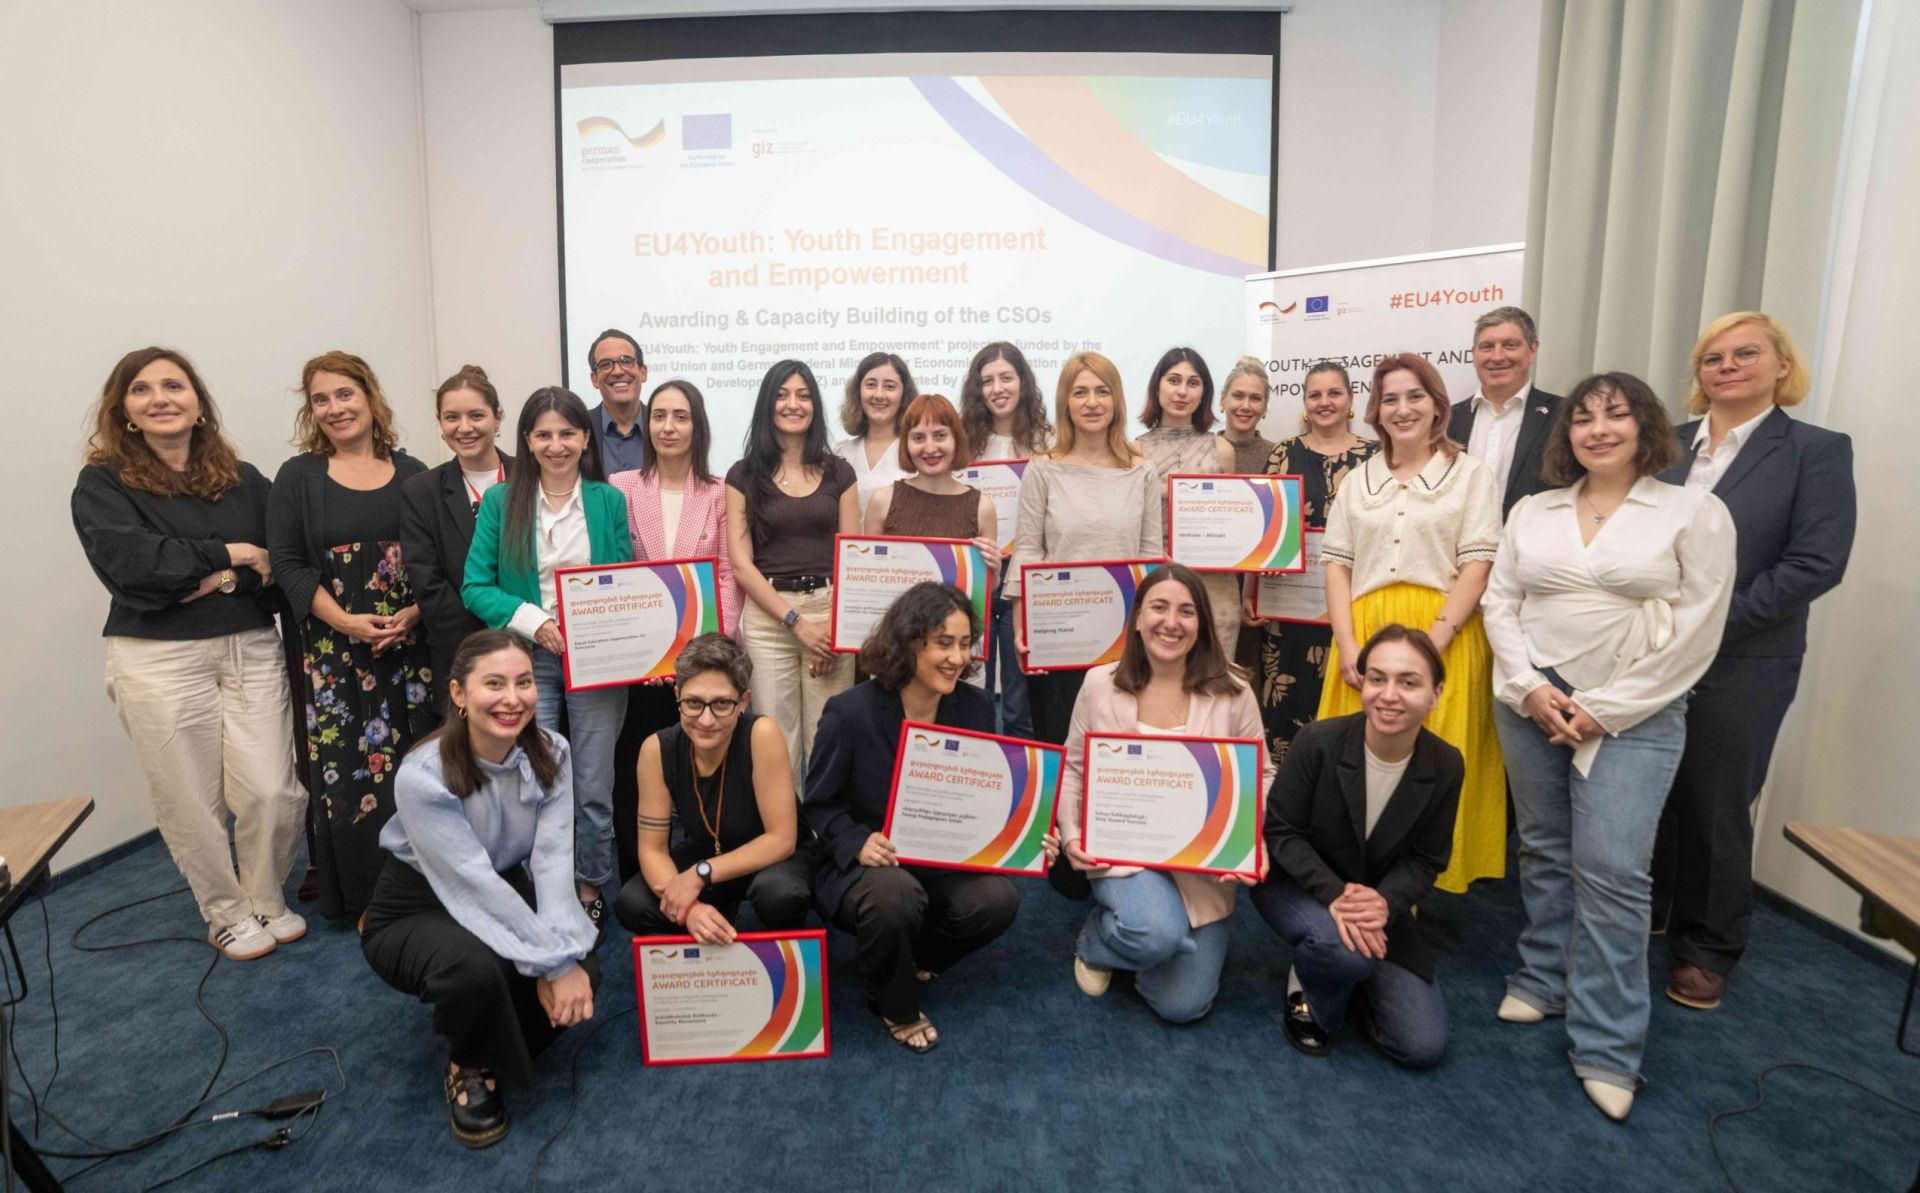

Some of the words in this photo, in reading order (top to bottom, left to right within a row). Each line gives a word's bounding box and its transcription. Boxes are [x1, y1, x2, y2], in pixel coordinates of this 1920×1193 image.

[581, 146, 620, 159] german
[752, 141, 774, 158] giz
[581, 155, 627, 165] cooperation
[634, 231, 774, 257] EU4Youth:
[785, 227, 862, 252] Youth
[872, 227, 1047, 256] Engagement
[708, 264, 759, 288] and
[769, 261, 969, 291] Empowerment
[1389, 284, 1504, 310] #EU4Youth
[639, 311, 729, 331] Awarding
[736, 309, 749, 326] &
[755, 307, 840, 329] Capacity
[847, 306, 928, 327] Building
[934, 306, 954, 324] of
[960, 306, 990, 323] the
[996, 306, 1052, 324] CSOs
[703, 341, 737, 354] Youth
[741, 340, 819, 354] Engagement
[822, 340, 845, 351] and
[1015, 339, 1061, 351] funded
[1063, 339, 1078, 352] by
[1082, 339, 1102, 351] the
[1437, 350, 1474, 365] AND
[671, 361, 707, 372] Union
[711, 360, 734, 371] and
[943, 375, 957, 387] by
[1207, 506, 1254, 514] CERTIFICATE
[845, 574, 878, 583] AWARD
[571, 607, 606, 617] AWARD
[607, 600, 664, 613] CERTIFICATE
[1032, 599, 1063, 607] AWARD
[1064, 596, 1114, 606] CERTIFICATE
[908, 769, 944, 782] AWARD
[945, 774, 1003, 790] CERTIFICATE
[1096, 776, 1131, 785] AWARD
[1133, 778, 1194, 790] CERTIFICATE
[652, 980, 691, 990] AWARD
[693, 977, 759, 988] CERTIFICATE
